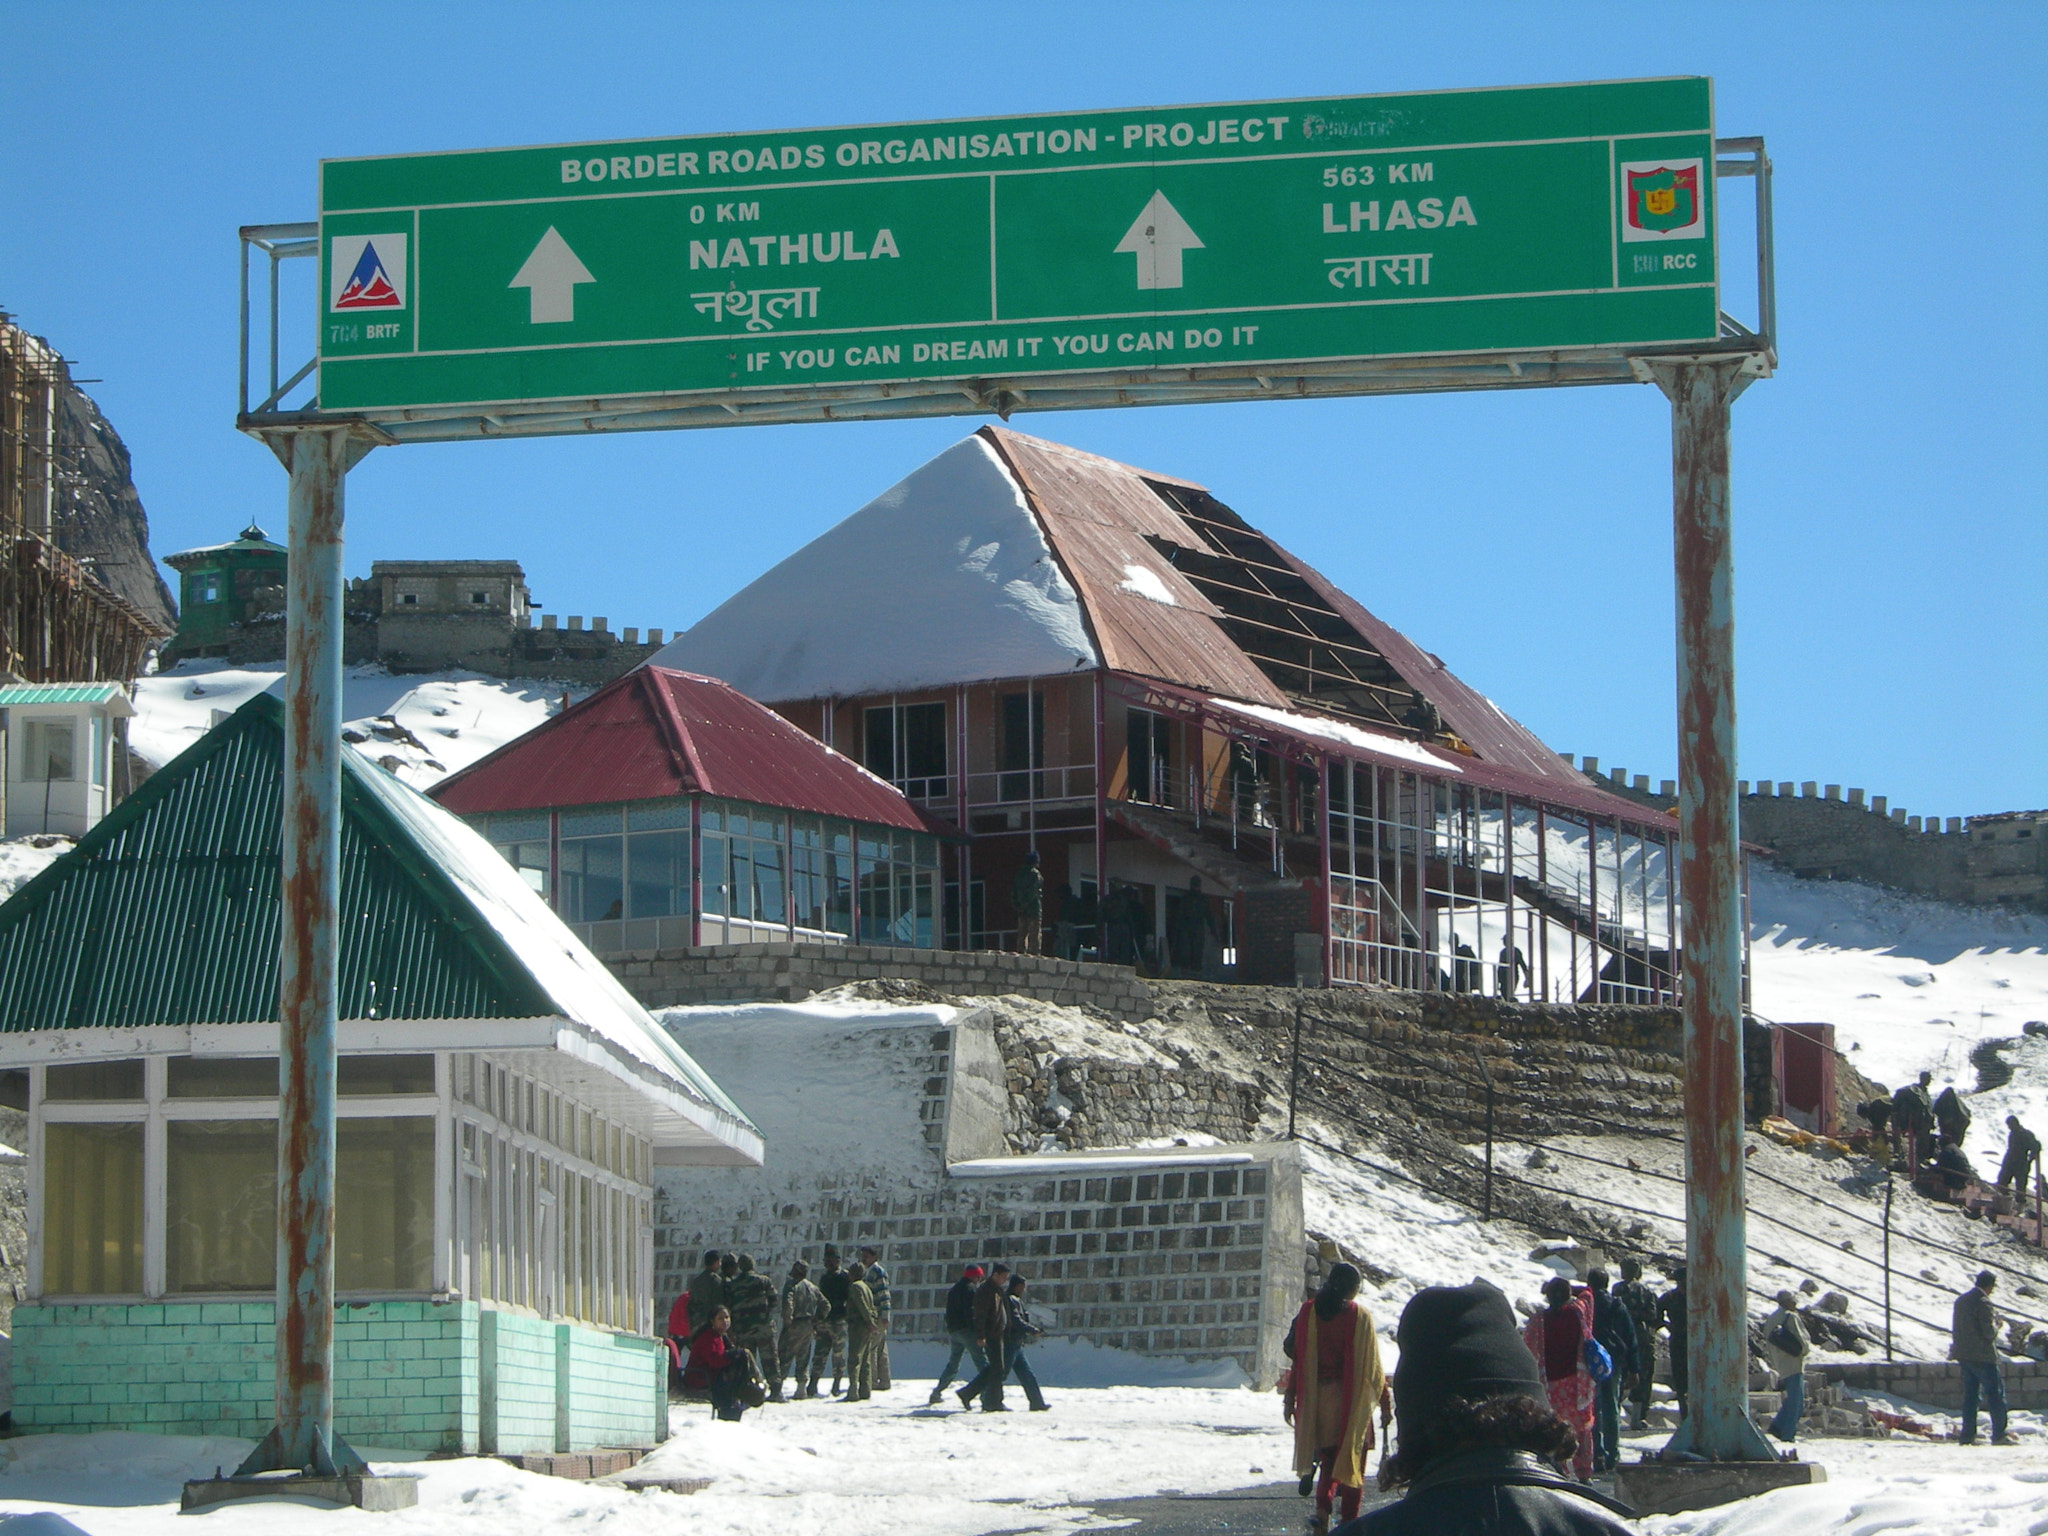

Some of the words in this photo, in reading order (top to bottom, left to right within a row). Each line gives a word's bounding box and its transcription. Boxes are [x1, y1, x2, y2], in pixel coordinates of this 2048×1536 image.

[561, 151, 700, 183] BORDER
[709, 145, 825, 174] ROADS
[836, 129, 1097, 168] ORGANISATION
[1123, 116, 1289, 149] PROJECT
[1323, 167, 1375, 187] 563
[1388, 162, 1433, 184] KM
[716, 202, 759, 223] KM
[1323, 196, 1477, 233] LHASA
[689, 228, 900, 270] NATHULA
[1663, 253, 1697, 270] RCC
[1323, 253, 1433, 289] लासा
[690, 286, 821, 332] नथूला
[366, 323, 400, 339] BRTF
[747, 352, 770, 372] IF
[779, 348, 835, 370] YOU
[844, 344, 900, 367] CAN
[913, 339, 1008, 363] DREAM
[1017, 337, 1043, 357] IT
[1052, 334, 1109, 355] YOU
[1117, 330, 1174, 353] CAN
[1184, 328, 1223, 349] DO
[1233, 326, 1259, 346] IT
